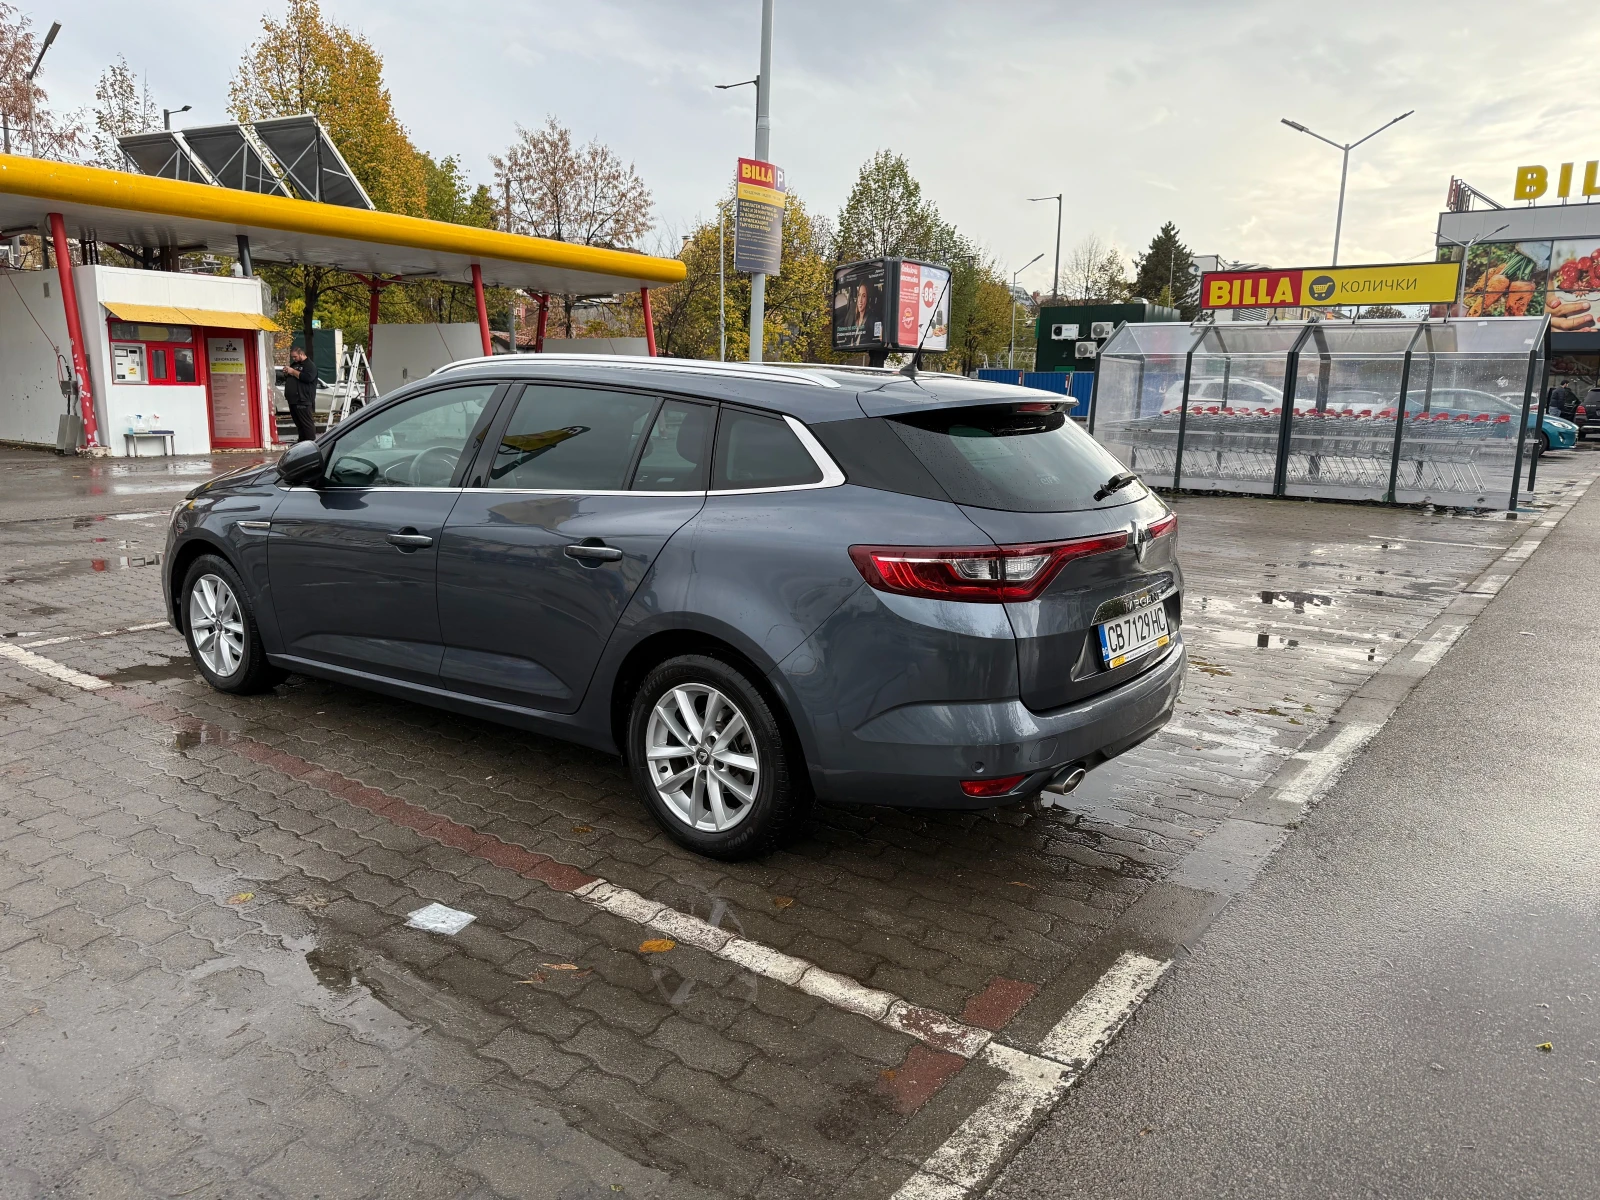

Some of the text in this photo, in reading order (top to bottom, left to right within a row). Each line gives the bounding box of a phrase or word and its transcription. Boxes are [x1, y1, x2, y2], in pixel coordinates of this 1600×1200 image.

[742, 163, 784, 188] BILLA P
[1208, 277, 1295, 306] BILLA
[1340, 278, 1418, 293] КОЛИЧКИ
[1108, 623, 1125, 653] CB
[1124, 612, 1151, 647] 7129
[1150, 607, 1166, 636] HC
